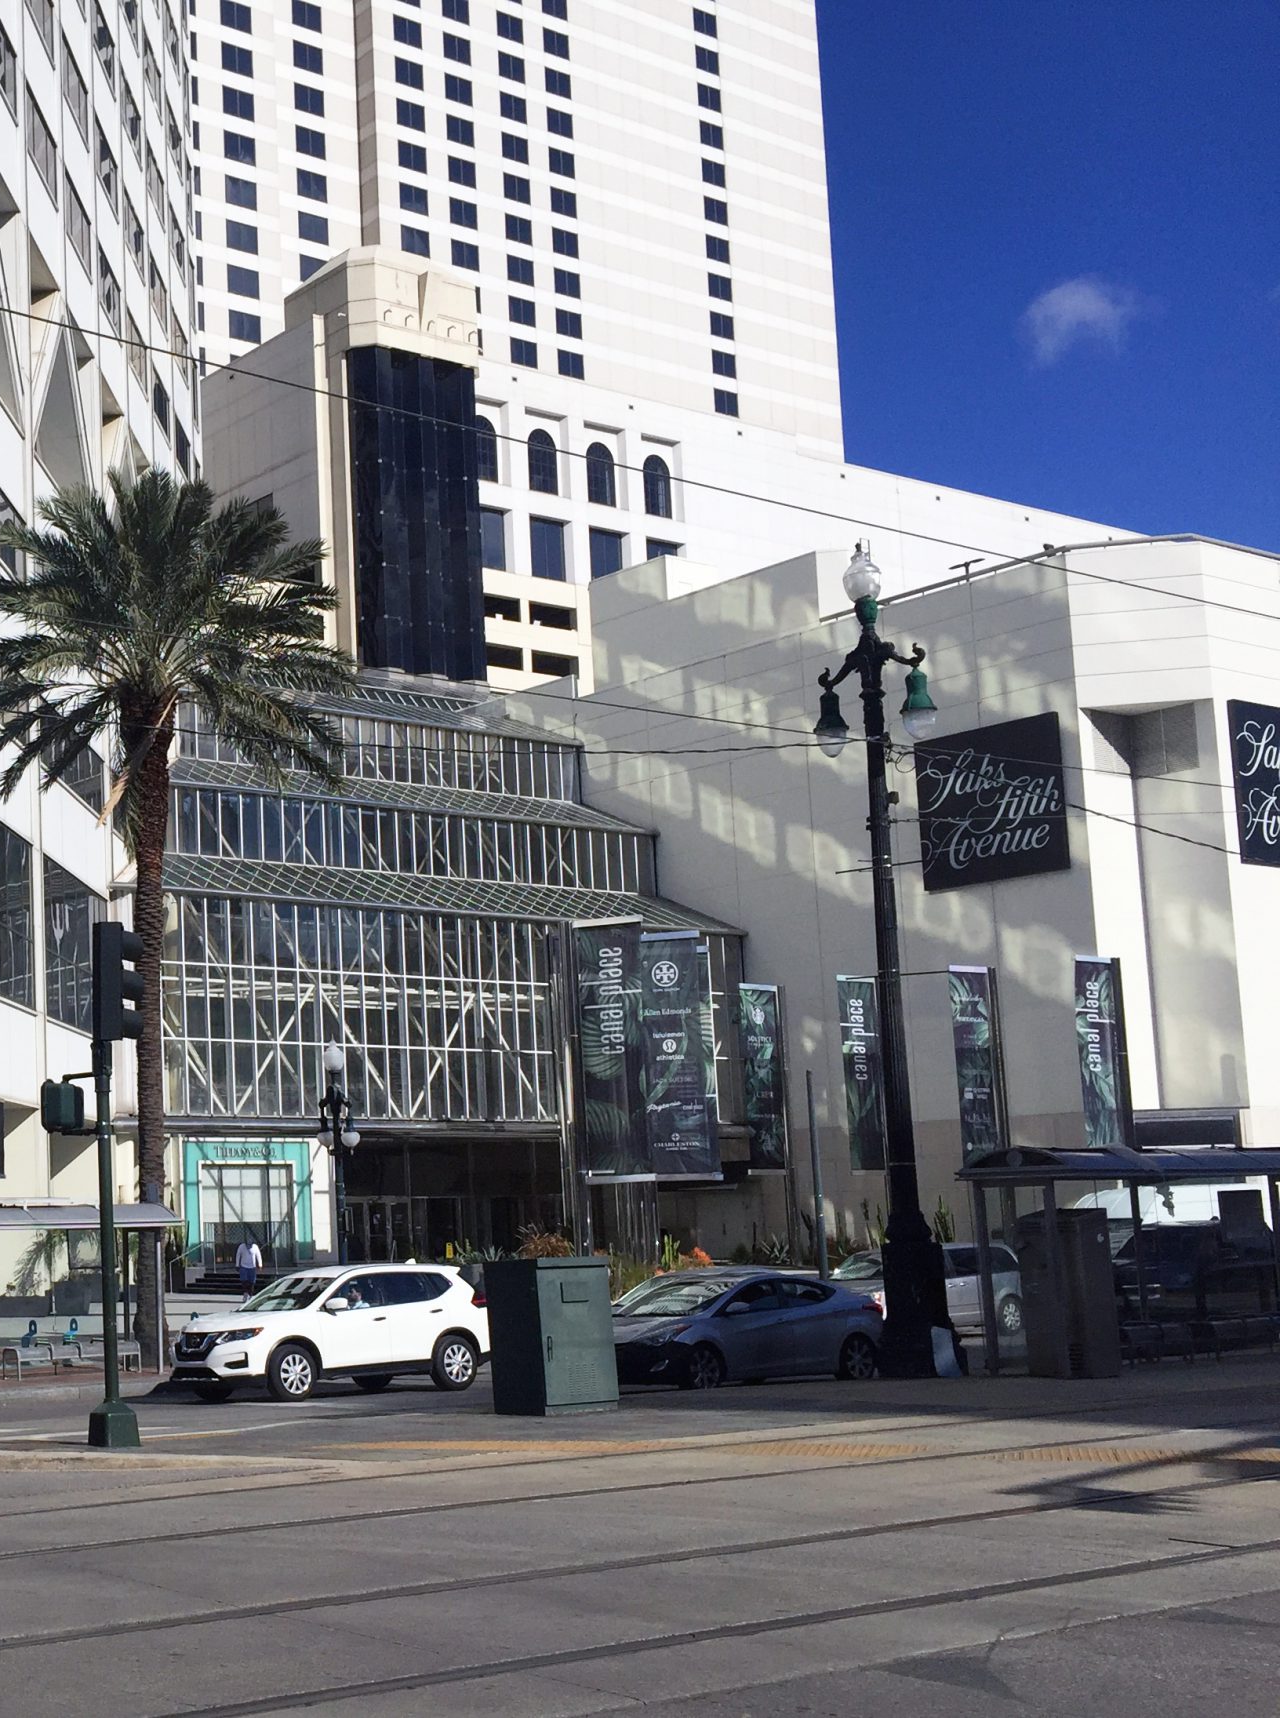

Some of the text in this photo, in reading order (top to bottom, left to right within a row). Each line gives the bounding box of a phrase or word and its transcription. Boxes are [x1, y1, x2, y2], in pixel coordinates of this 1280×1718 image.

[917, 749, 1007, 813] Saks
[921, 820, 1050, 873] Avenue
[581, 947, 642, 1055] canal place
[840, 998, 875, 1081] canal place
[1075, 981, 1112, 1072] canal place
